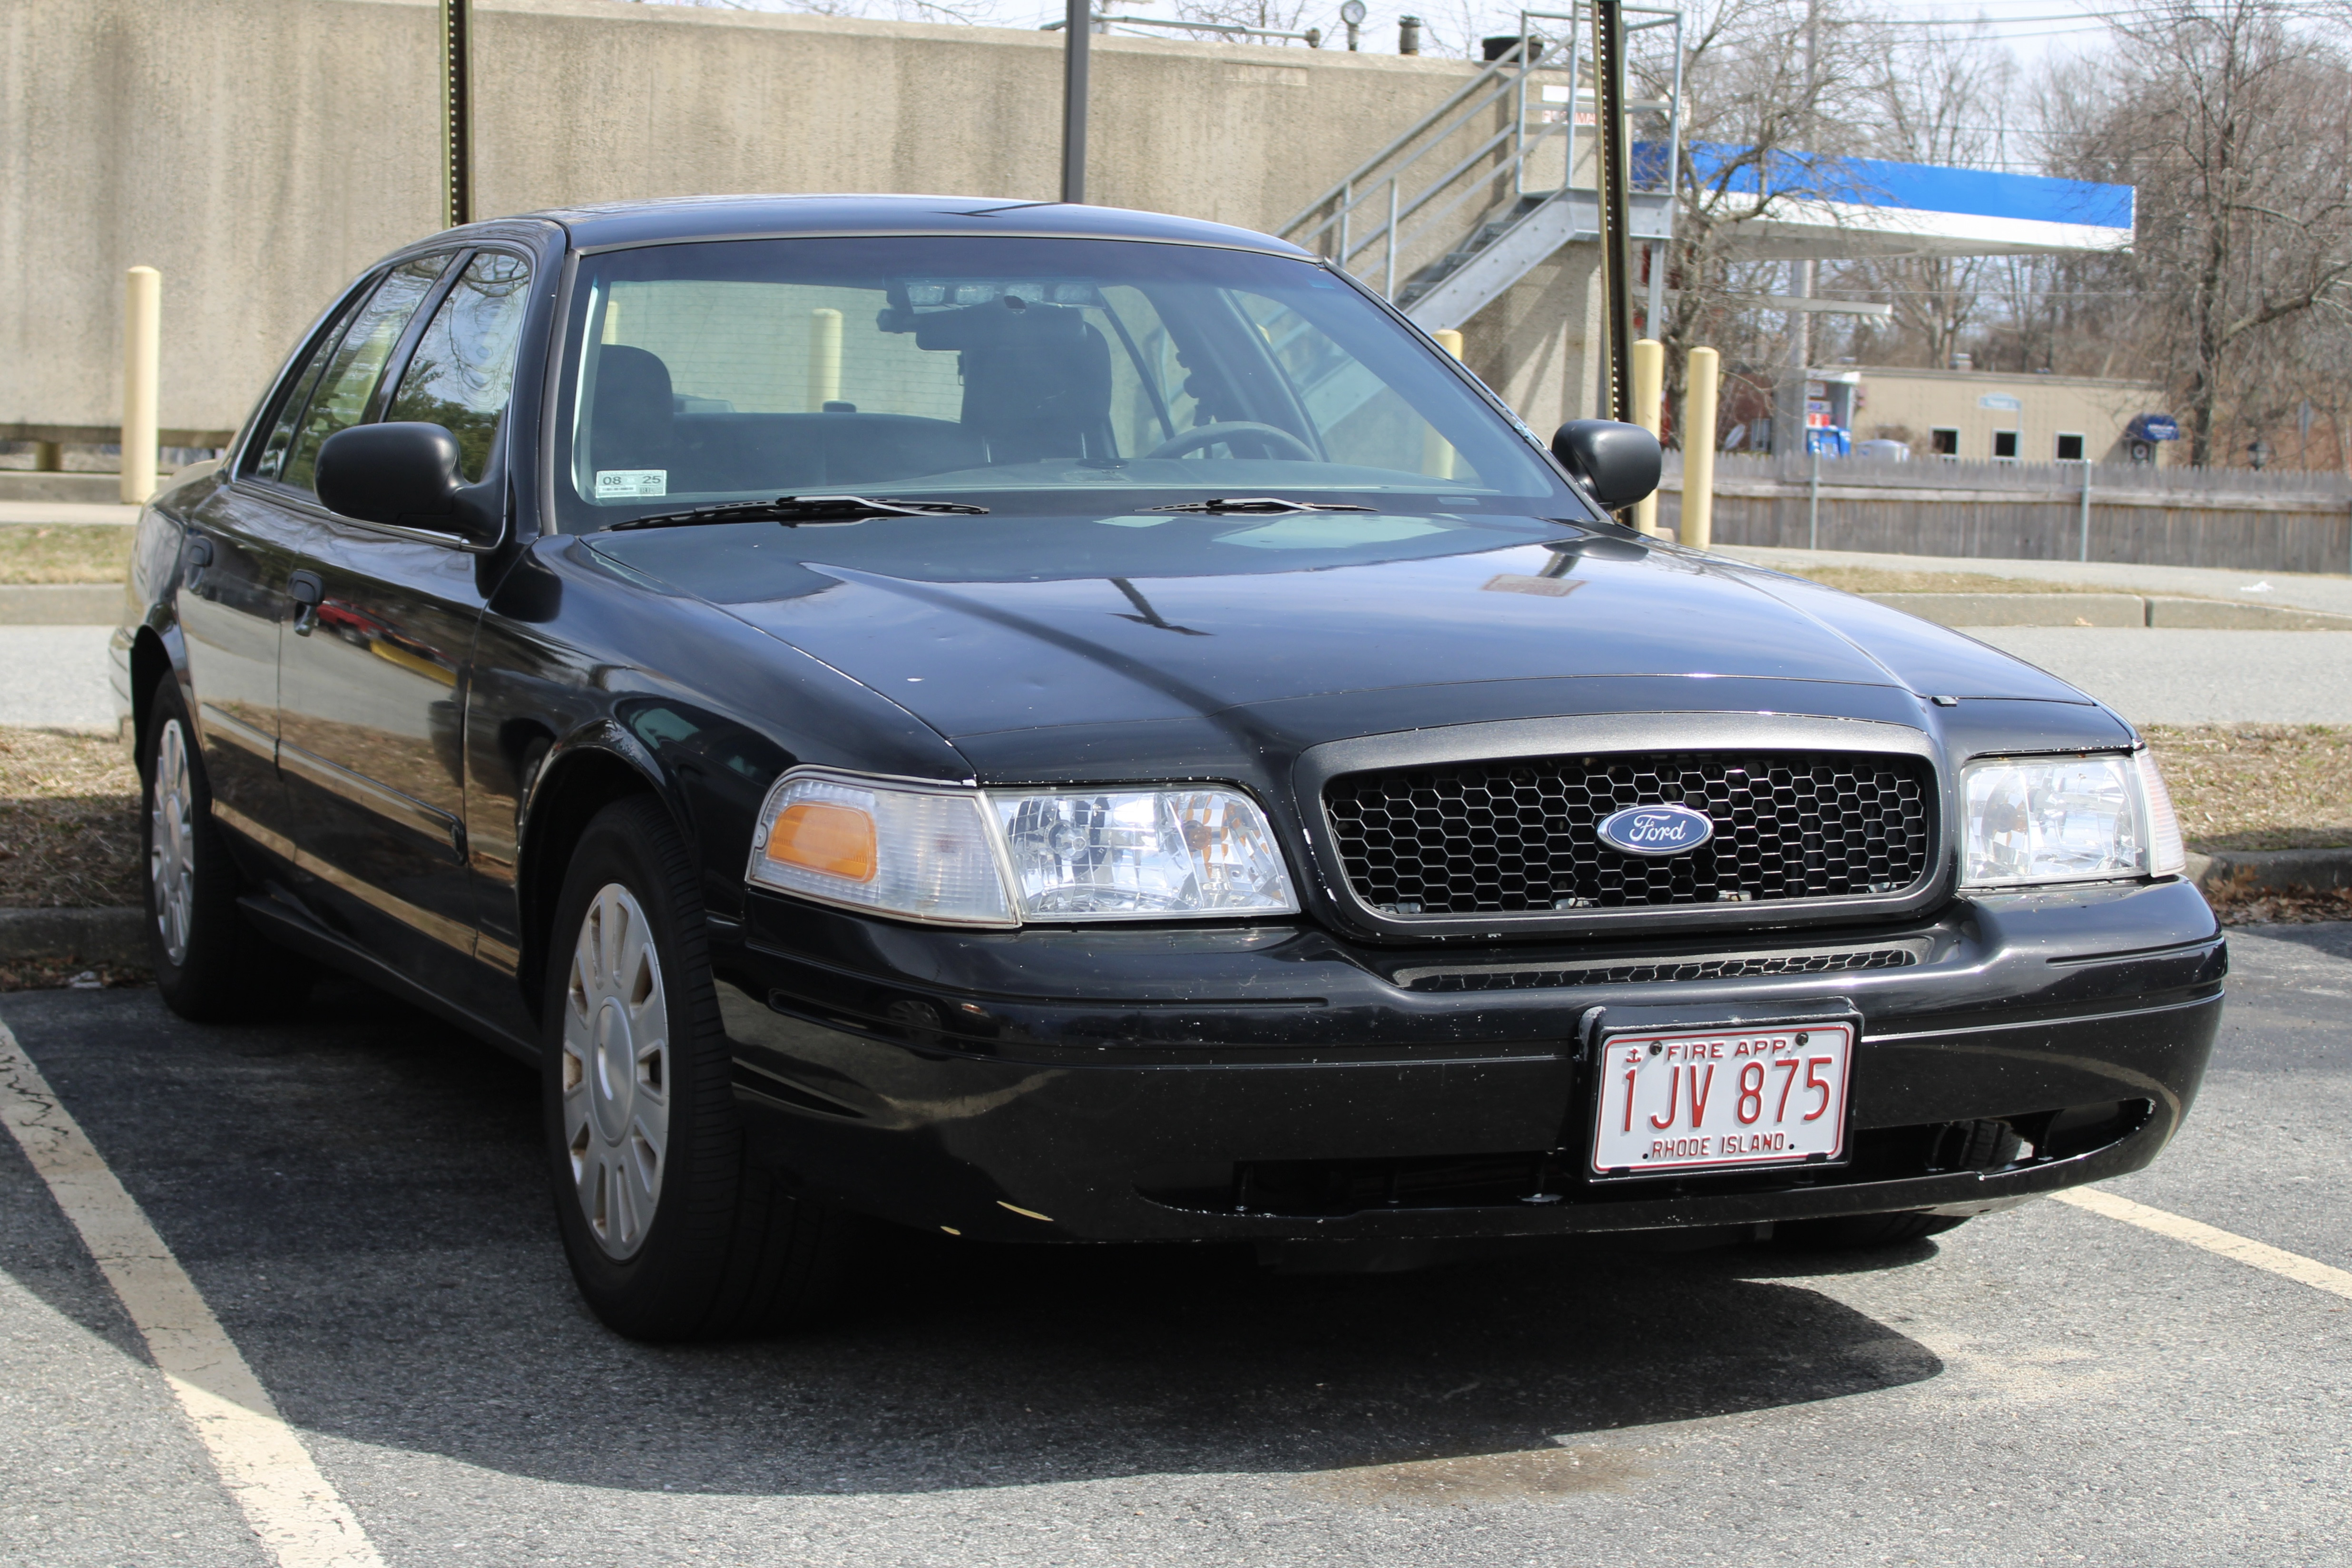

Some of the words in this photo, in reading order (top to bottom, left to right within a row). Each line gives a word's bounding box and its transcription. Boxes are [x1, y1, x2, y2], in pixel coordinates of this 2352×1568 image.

[603, 476, 621, 485] 08
[642, 476, 661, 484] 25
[1629, 815, 1686, 842] Ford
[1667, 1042, 1725, 1060] FIRE
[1734, 1039, 1792, 1057] APP.
[1737, 1057, 1833, 1125] 875
[1651, 1136, 1711, 1158] RHODE
[1720, 1132, 1784, 1154] ISLAND
